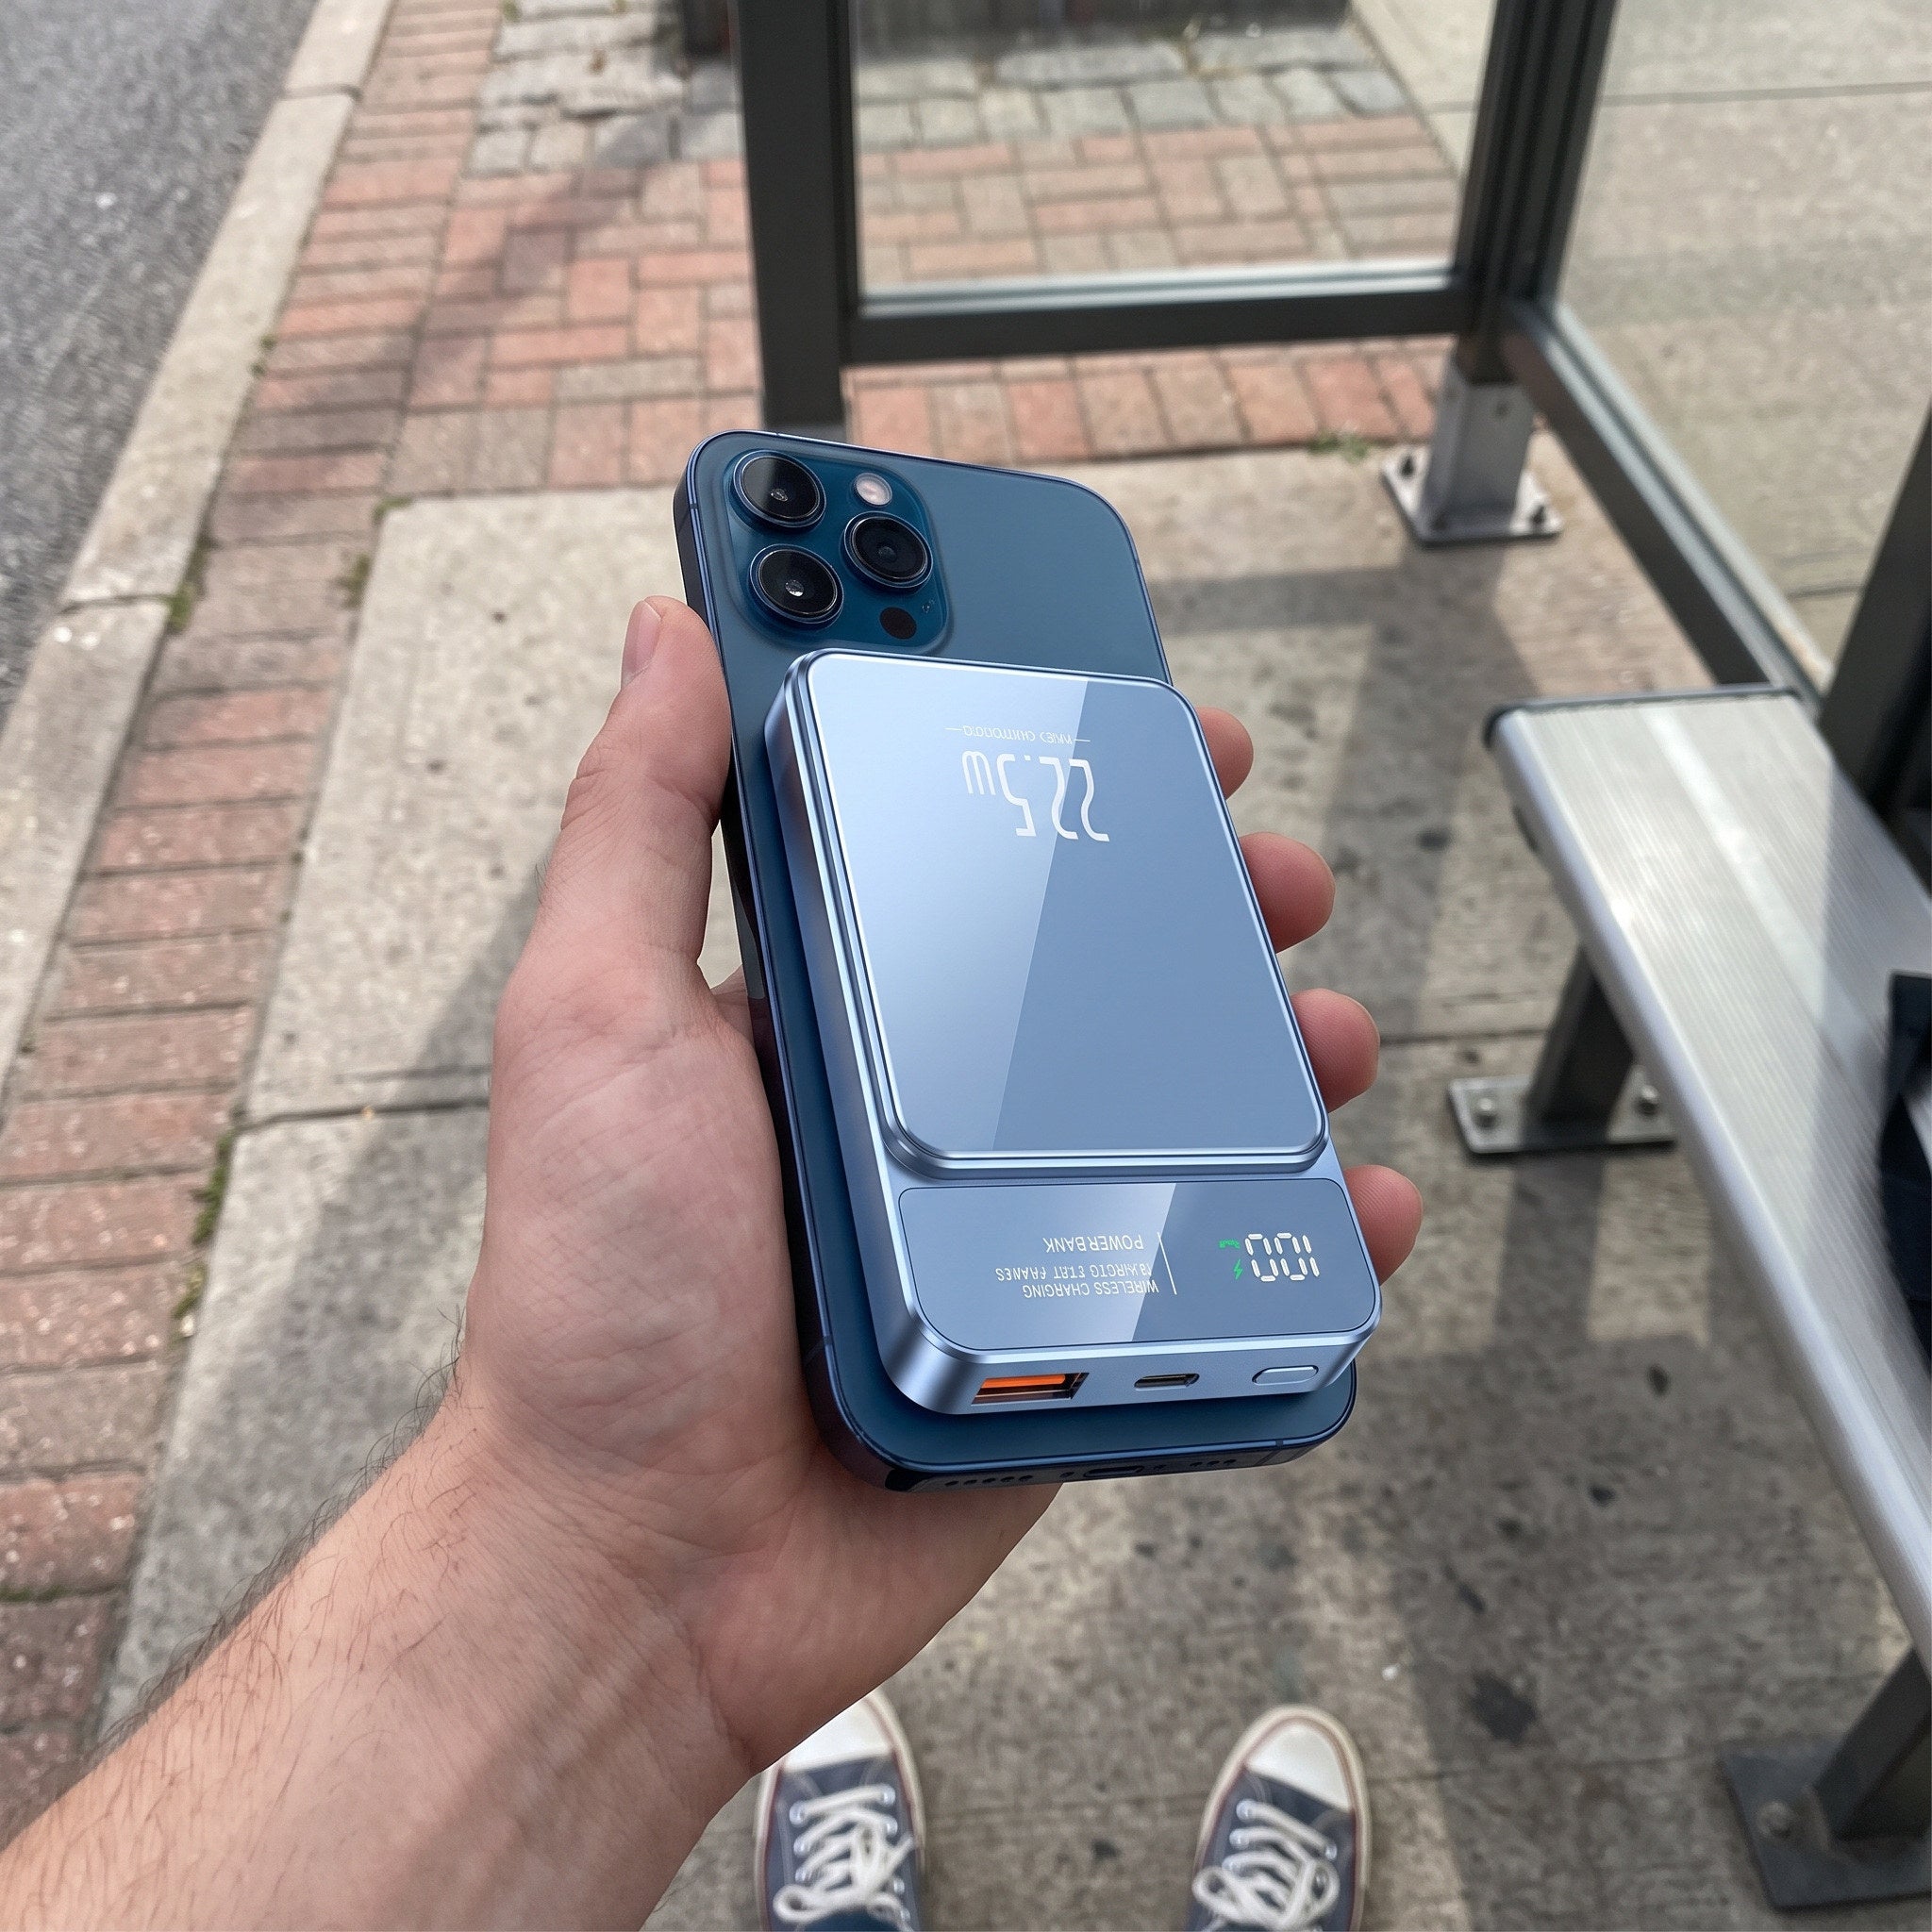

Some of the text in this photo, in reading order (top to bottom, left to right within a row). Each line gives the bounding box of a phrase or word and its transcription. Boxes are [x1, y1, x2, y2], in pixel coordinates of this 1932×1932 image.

[1244, 1232, 1321, 1282] 100
[1023, 1279, 1160, 1299] WIRELESS CHARGING
